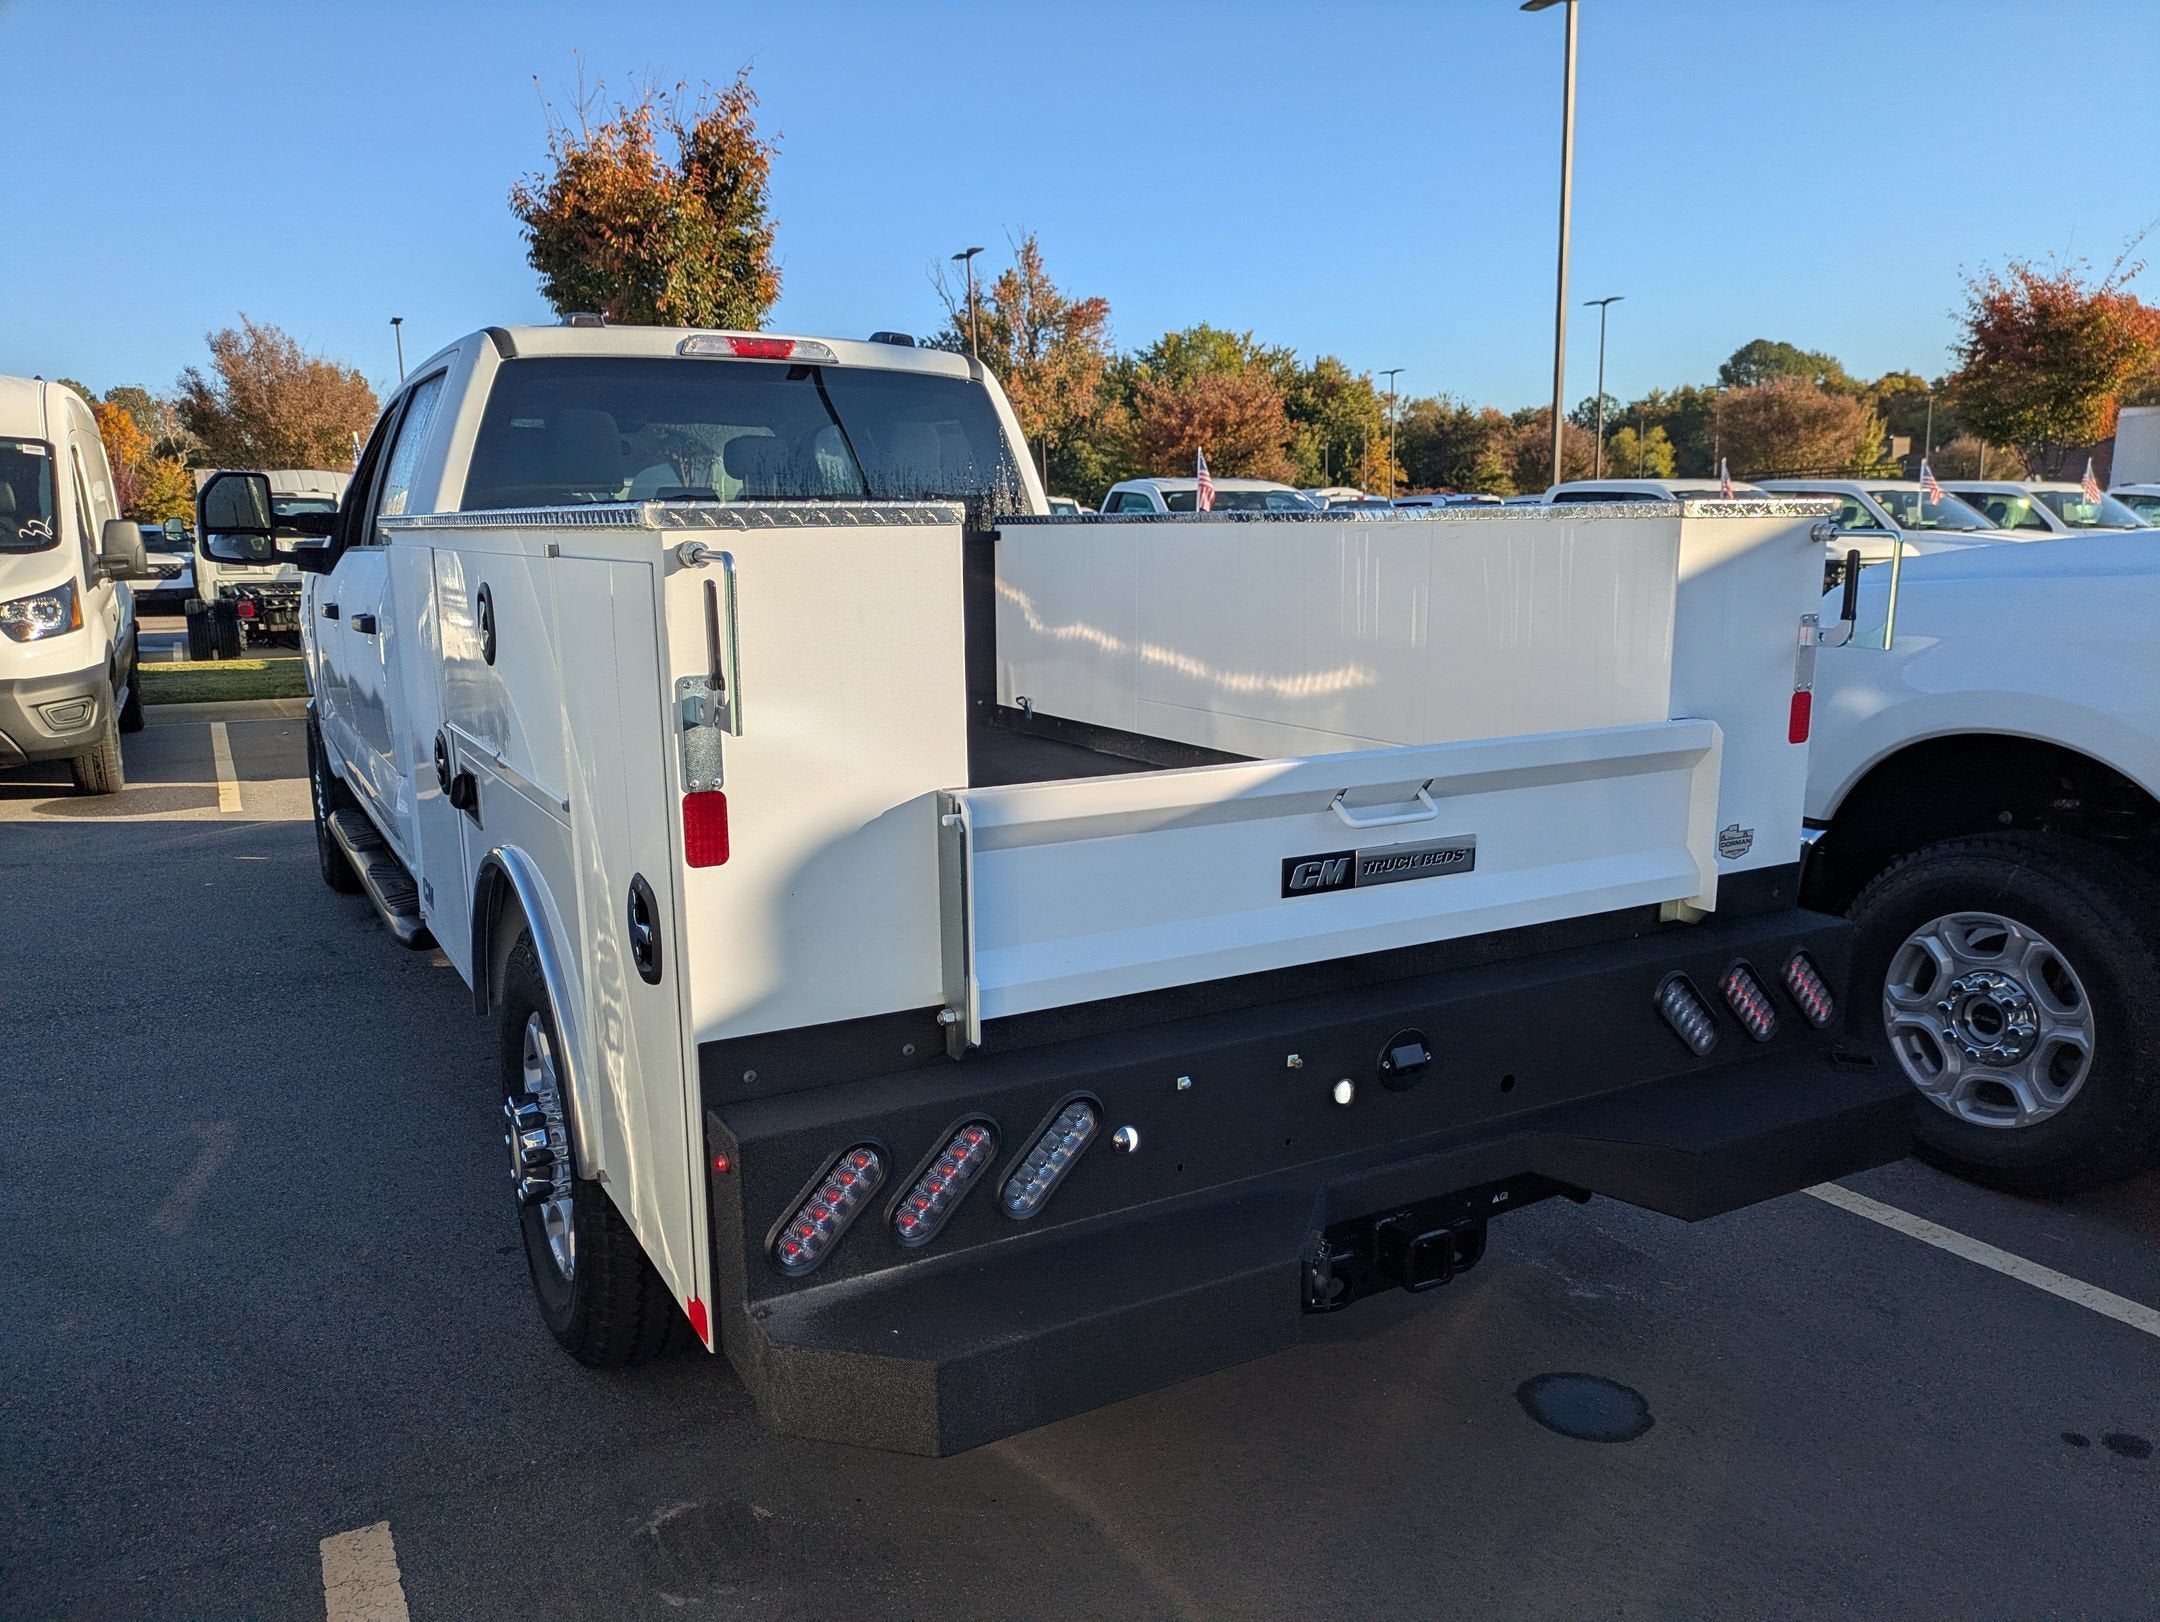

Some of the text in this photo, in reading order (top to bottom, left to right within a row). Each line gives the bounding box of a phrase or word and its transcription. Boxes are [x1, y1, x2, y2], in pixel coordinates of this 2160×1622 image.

[1289, 849, 1467, 890] CM TRUCK BEDS
